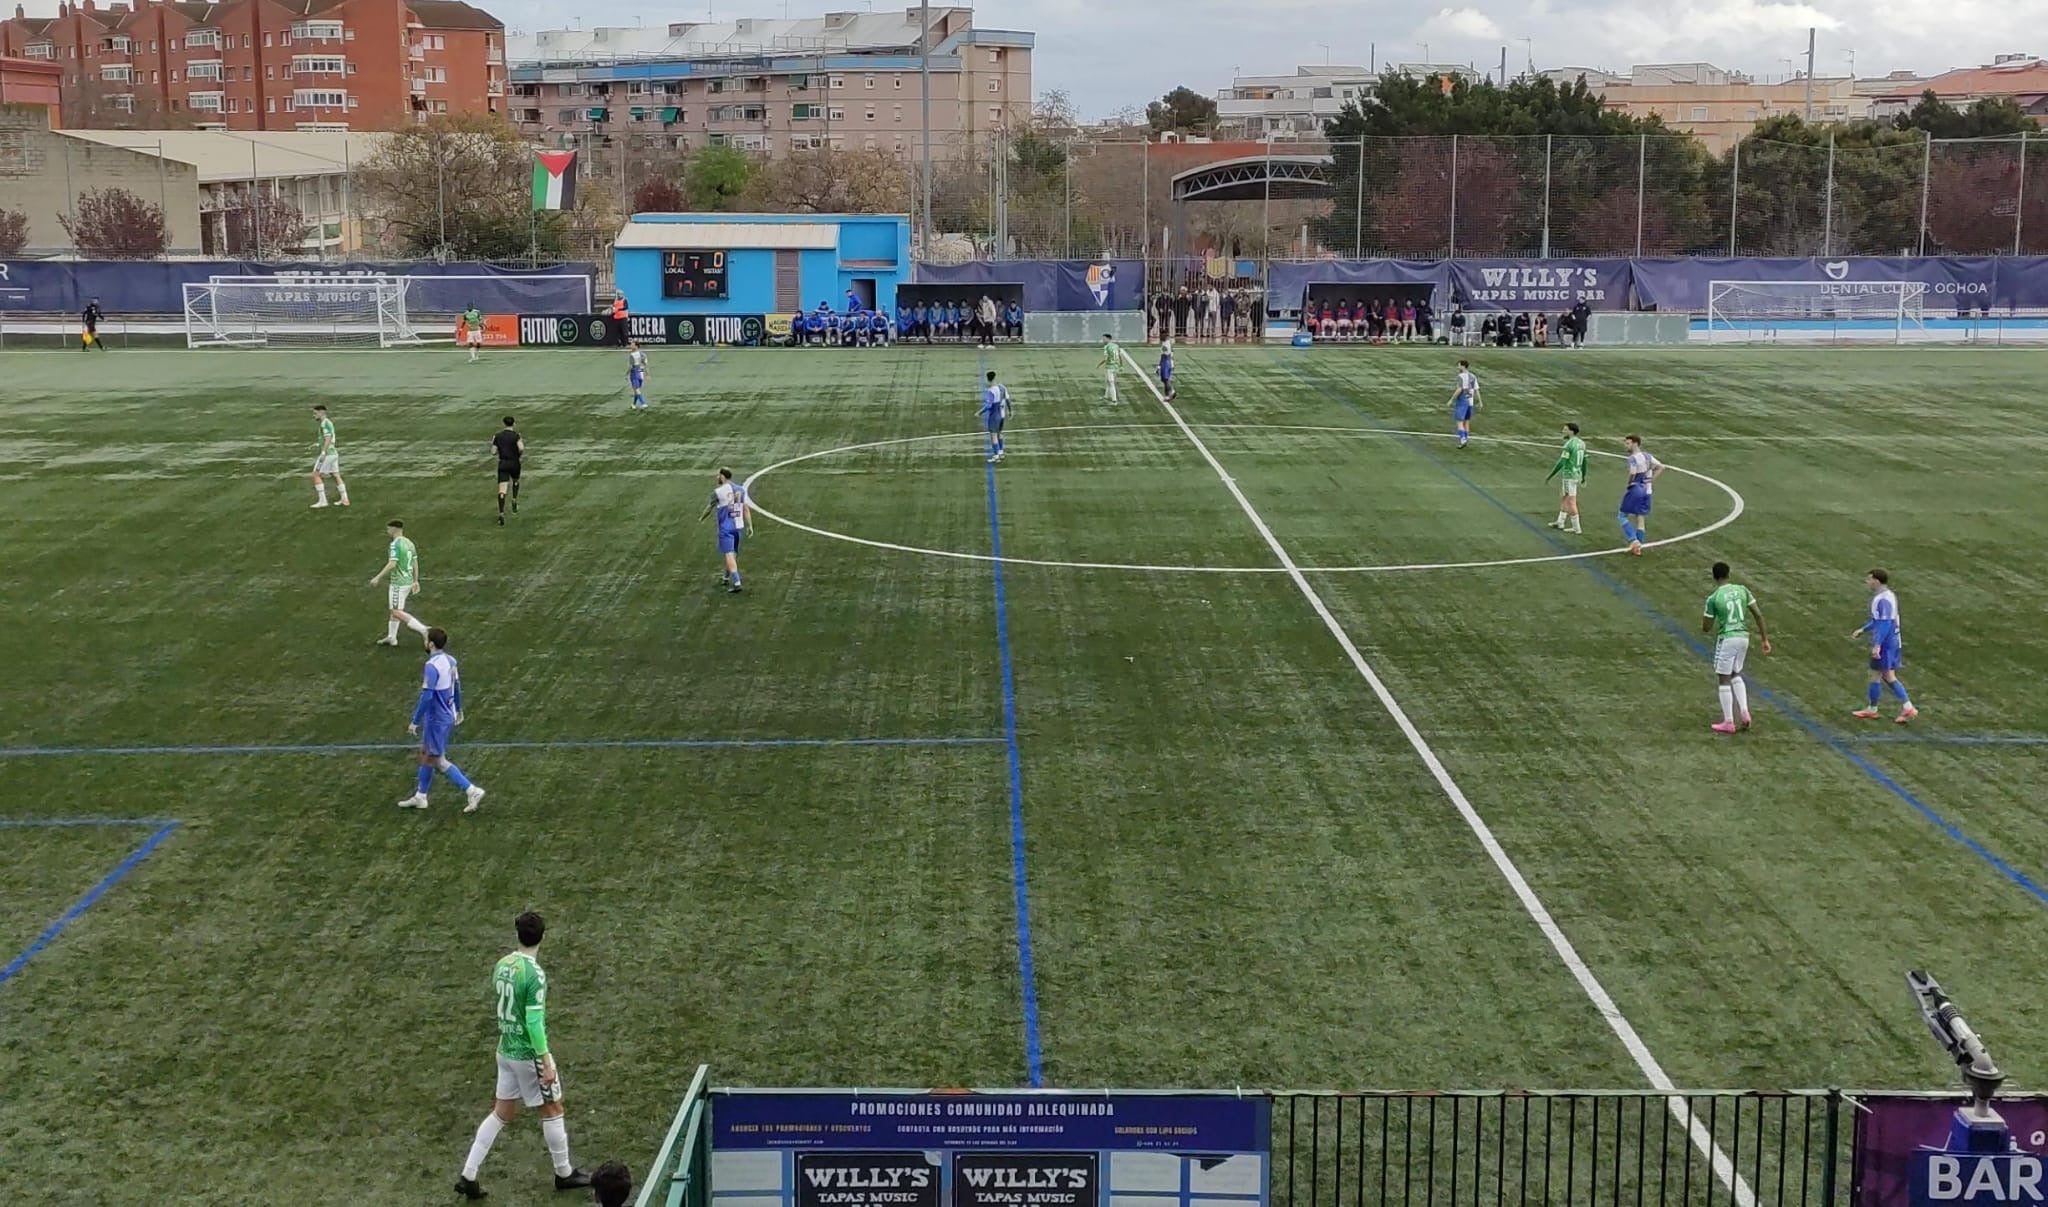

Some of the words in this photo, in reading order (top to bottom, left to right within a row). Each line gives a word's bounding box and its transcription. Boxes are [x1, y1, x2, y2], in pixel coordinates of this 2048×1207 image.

[713, 251, 724, 268] 0
[1480, 267, 1598, 288] WILLY'S
[264, 291, 312, 302] TAPAS
[316, 291, 362, 302] MUSIC
[1471, 289, 1517, 301] TAPAS
[1522, 289, 1570, 301] MUSIC
[1576, 289, 1606, 301] BAR
[1820, 283, 1877, 294] DENTAL
[1882, 282, 1931, 294] CLNIC
[1934, 282, 1987, 294] OCHOA
[1726, 598, 1745, 624] 21
[496, 979, 517, 1023] 22
[851, 1102, 942, 1116] PROMOCIONES
[947, 1102, 1022, 1116] COMUNIDAD
[1027, 1102, 1115, 1116] ARLEQUINADA
[804, 1167, 931, 1188] WILLY'S
[962, 1167, 1089, 1188] WILLY'S
[1928, 1155, 2045, 1201] BAR
[818, 1192, 866, 1203] TAPAS
[869, 1192, 919, 1203] MUSIC
[975, 1192, 1023, 1203] TAPAS
[1026, 1192, 1076, 1203] MUSIC
